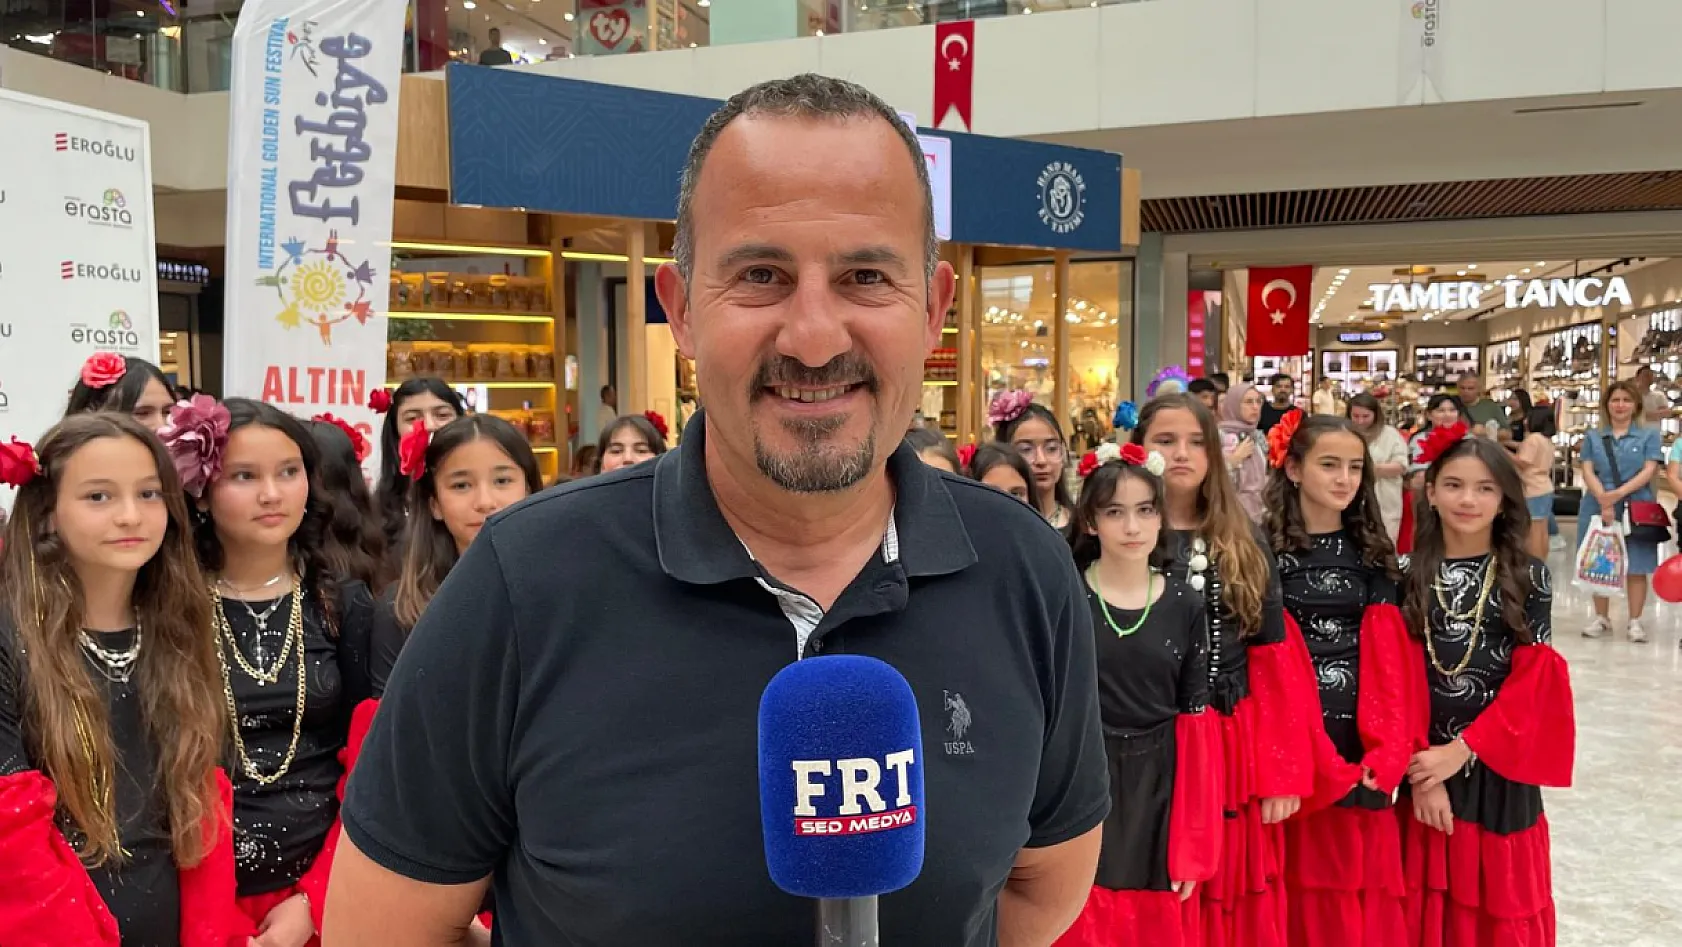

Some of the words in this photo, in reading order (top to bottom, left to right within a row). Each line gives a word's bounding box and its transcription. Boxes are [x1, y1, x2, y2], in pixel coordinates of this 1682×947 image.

[593, 13, 627, 43] ty
[265, 17, 290, 73] FESTIVAL
[264, 76, 282, 105] SUN
[71, 136, 135, 162] EROĞLU
[262, 109, 280, 162] GOLDEN
[1036, 161, 1061, 187] HAND
[1063, 162, 1087, 190] MADE
[64, 201, 132, 225] erasta
[259, 167, 278, 269] INTERNATIONAL
[77, 263, 141, 283] EROĞLU
[1369, 281, 1482, 312] TAMER
[71, 328, 138, 346] erasta
[262, 366, 365, 405] ALTIN
[944, 741, 975, 755] USPA
[792, 748, 914, 816] FRT
[801, 821, 842, 834] SED
[849, 810, 913, 832] MEDYA
